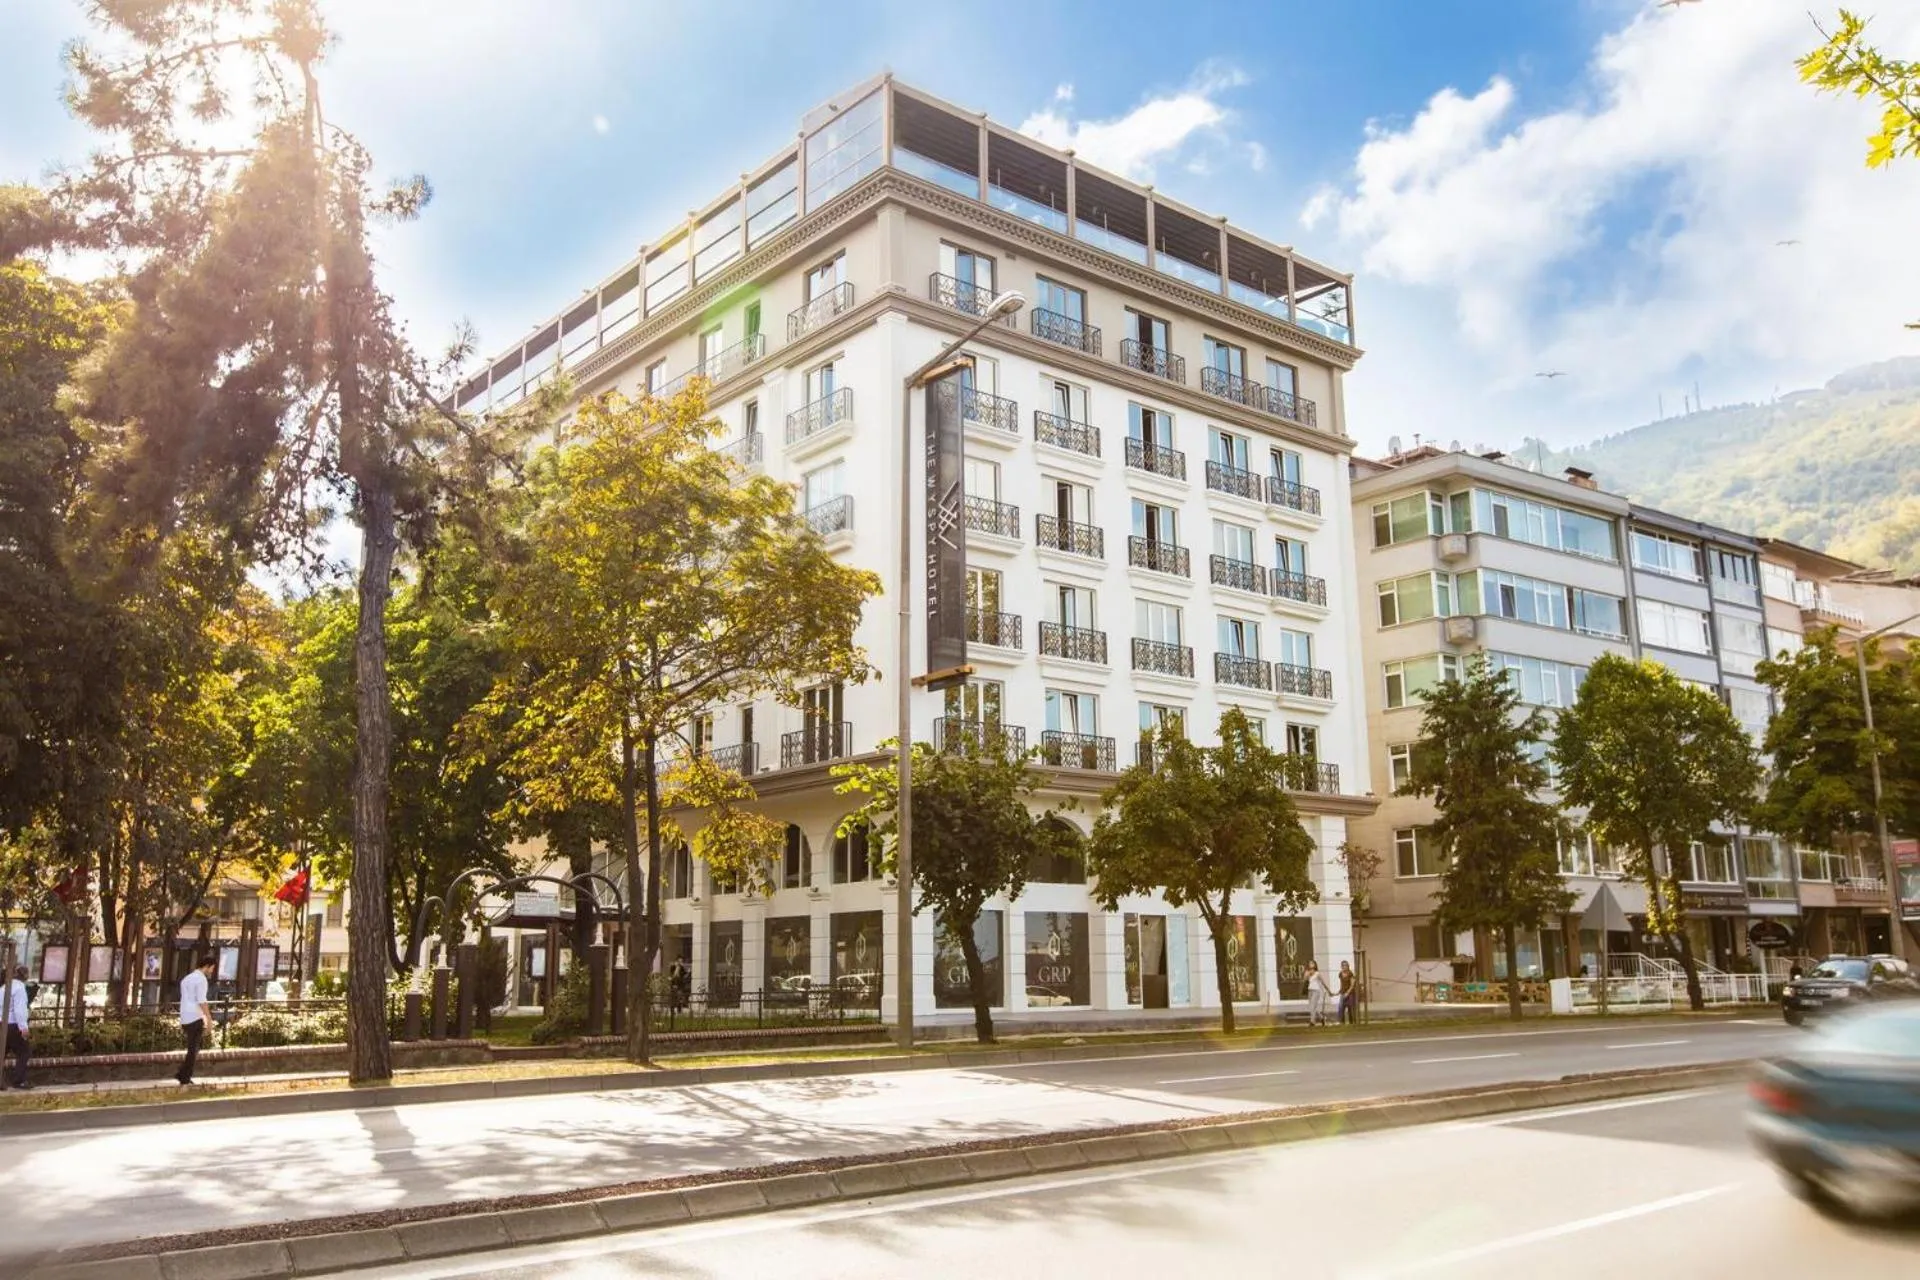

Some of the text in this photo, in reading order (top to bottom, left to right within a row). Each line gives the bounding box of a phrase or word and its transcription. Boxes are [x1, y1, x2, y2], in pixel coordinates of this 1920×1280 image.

[927, 431, 937, 620] THE WYSPY HOTEL
[1037, 966, 1071, 983] GRP
[1280, 965, 1305, 981] GRP
